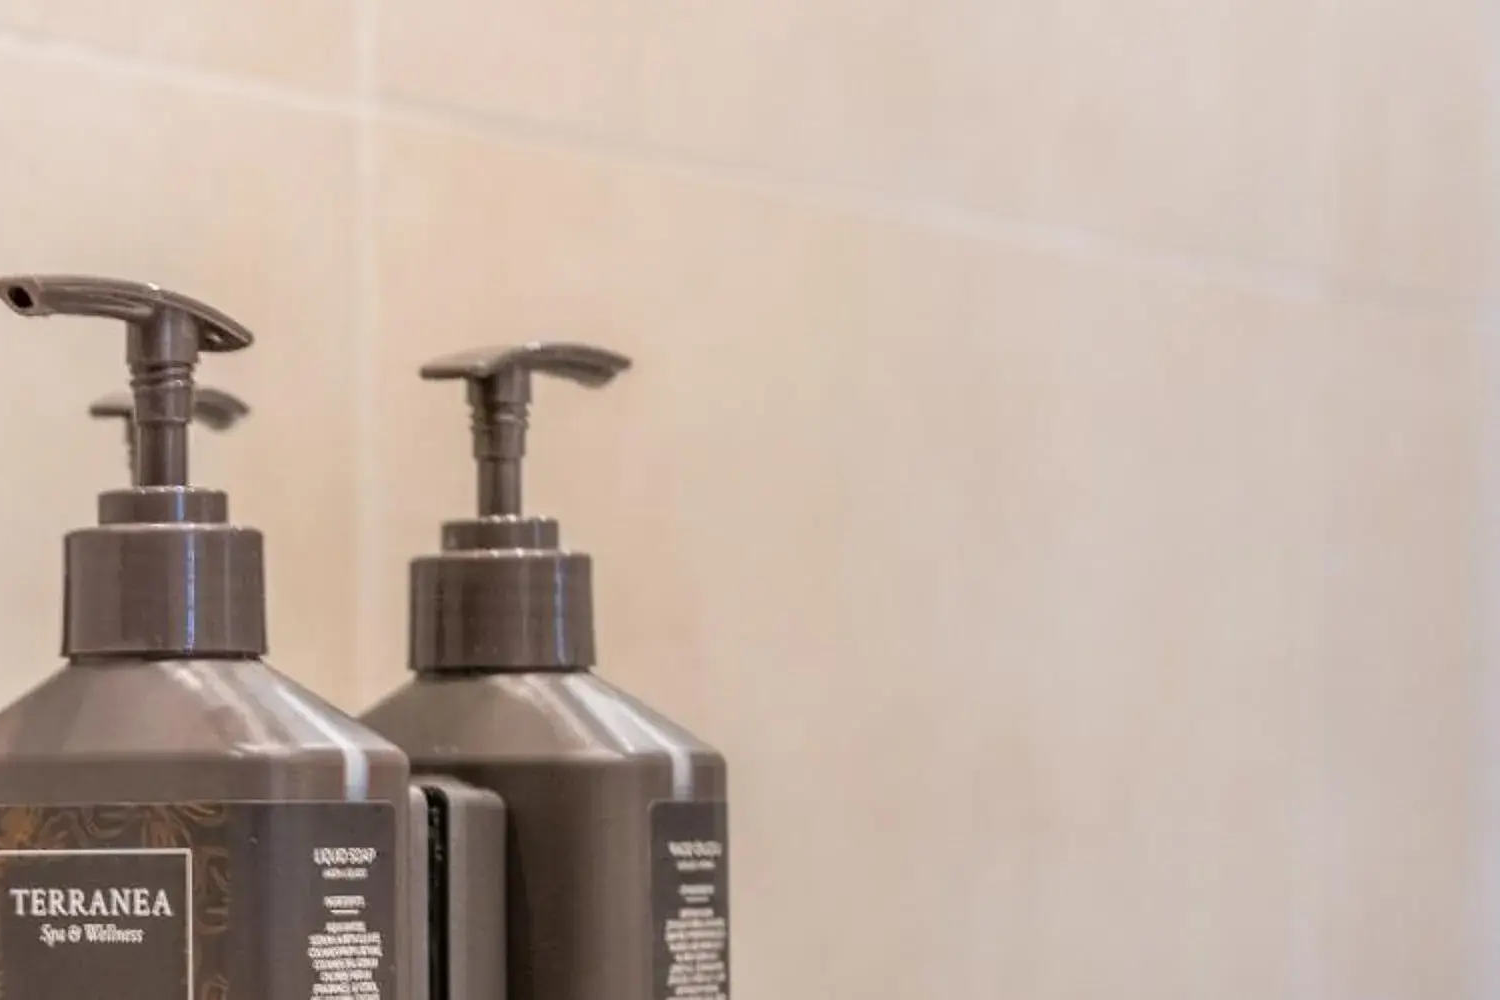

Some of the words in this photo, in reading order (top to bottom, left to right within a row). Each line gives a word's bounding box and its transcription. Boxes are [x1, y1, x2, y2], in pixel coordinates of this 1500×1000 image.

[9, 887, 174, 917] TERRANEA
[39, 923, 66, 947] Spa
[67, 924, 82, 943] &
[83, 923, 145, 944] Wellness
